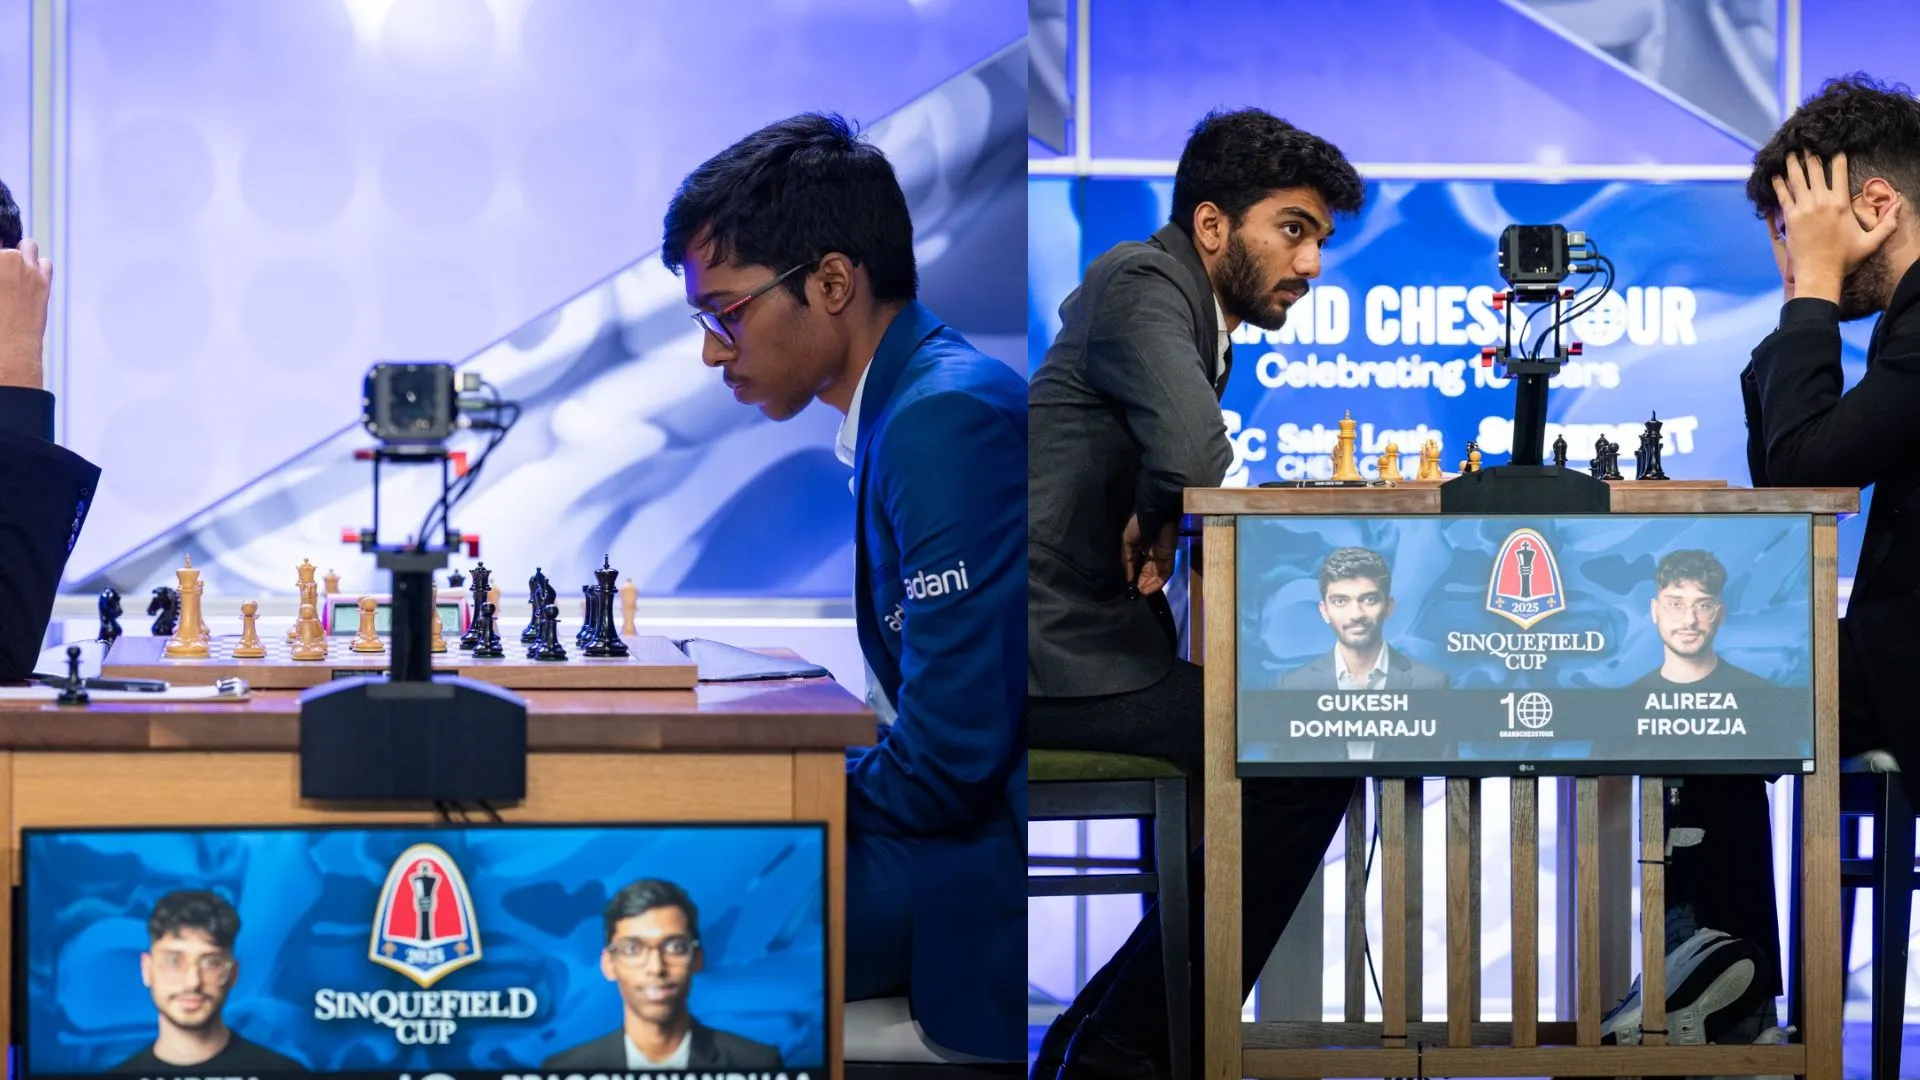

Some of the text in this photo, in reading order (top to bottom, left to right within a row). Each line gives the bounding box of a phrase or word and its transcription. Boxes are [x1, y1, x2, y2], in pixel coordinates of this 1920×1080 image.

[1365, 285, 1532, 346] CHESS
[1256, 352, 1467, 397] Celebrating
[1277, 423, 1342, 454] Sain
[903, 560, 969, 600] adani
[1511, 602, 1540, 613] 2025
[1447, 631, 1606, 658] SINQUEFIELD
[1505, 653, 1548, 670] CUP
[1316, 693, 1409, 712] GUKESH
[1643, 692, 1738, 711] ALIREZA
[1289, 719, 1437, 738] DOMMARAJU
[1636, 717, 1747, 736] FIROUZJA
[314, 987, 538, 1028] SINQUEFIELD
[395, 1018, 458, 1045] CUP
